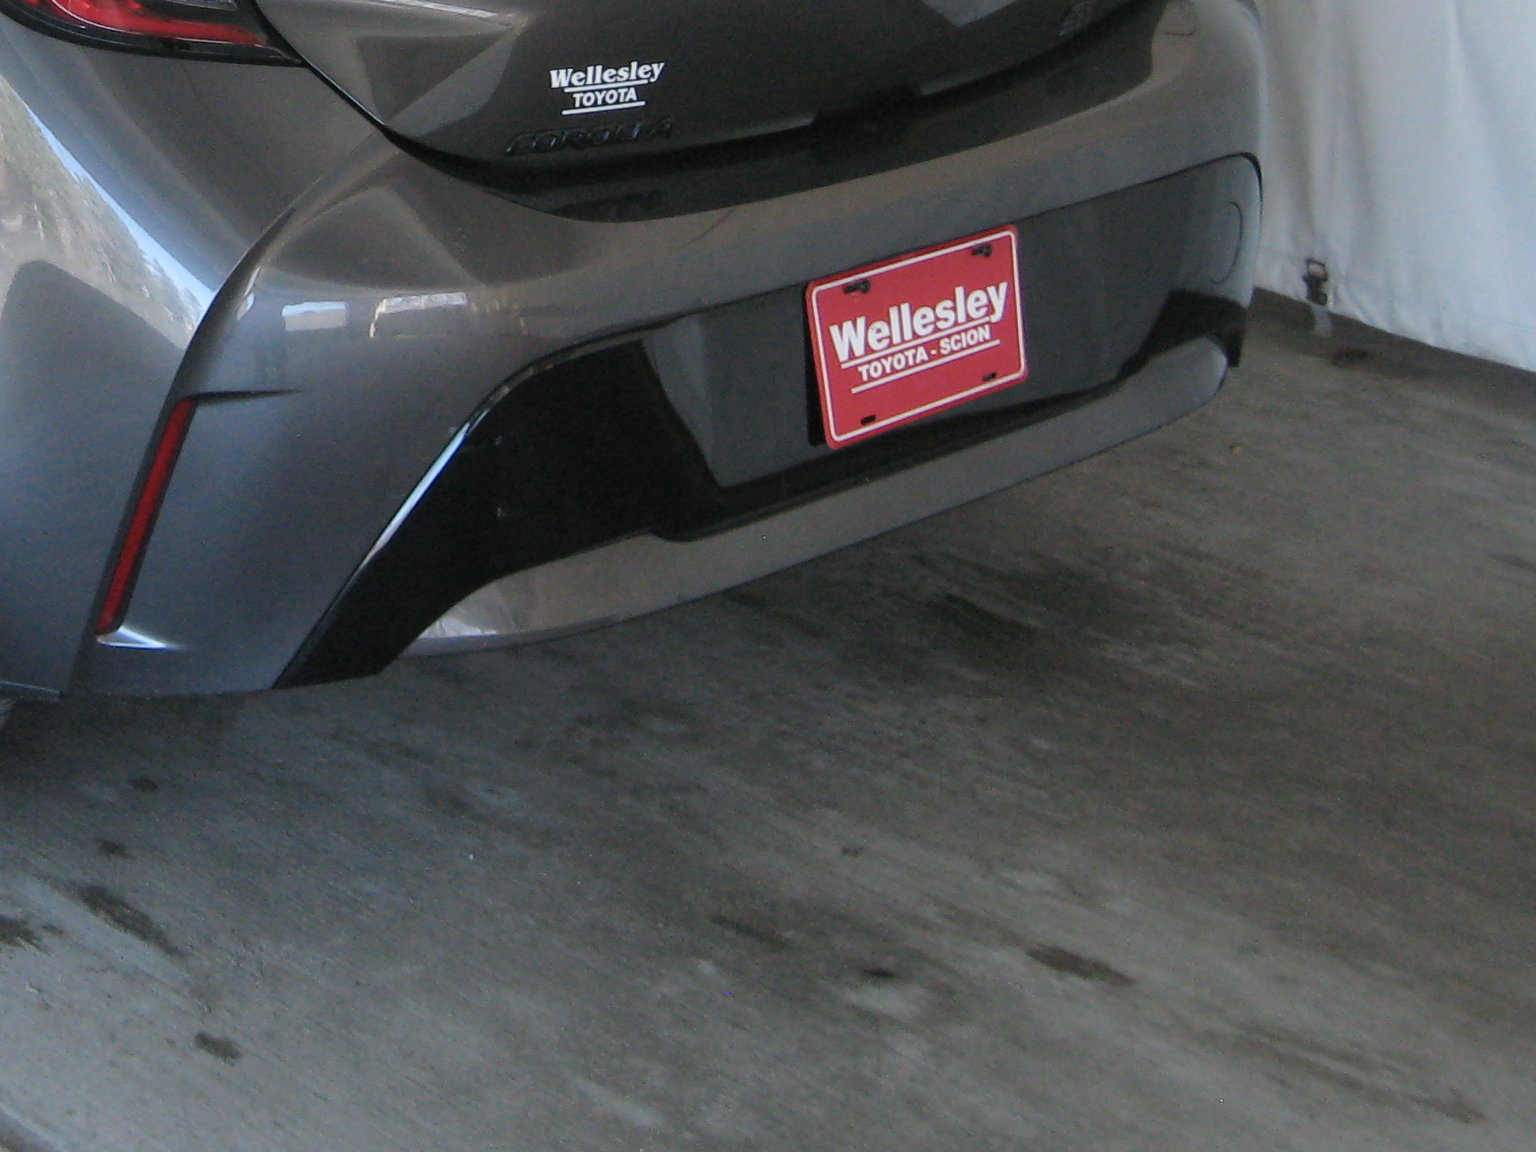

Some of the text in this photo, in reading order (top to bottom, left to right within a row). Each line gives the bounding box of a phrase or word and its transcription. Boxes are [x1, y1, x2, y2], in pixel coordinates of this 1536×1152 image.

[549, 61, 665, 89] Wellesley
[572, 88, 637, 108] TOYOTA
[829, 282, 1008, 362] Wellesley
[858, 348, 929, 381] TOYOTA
[939, 325, 991, 356] SCION
